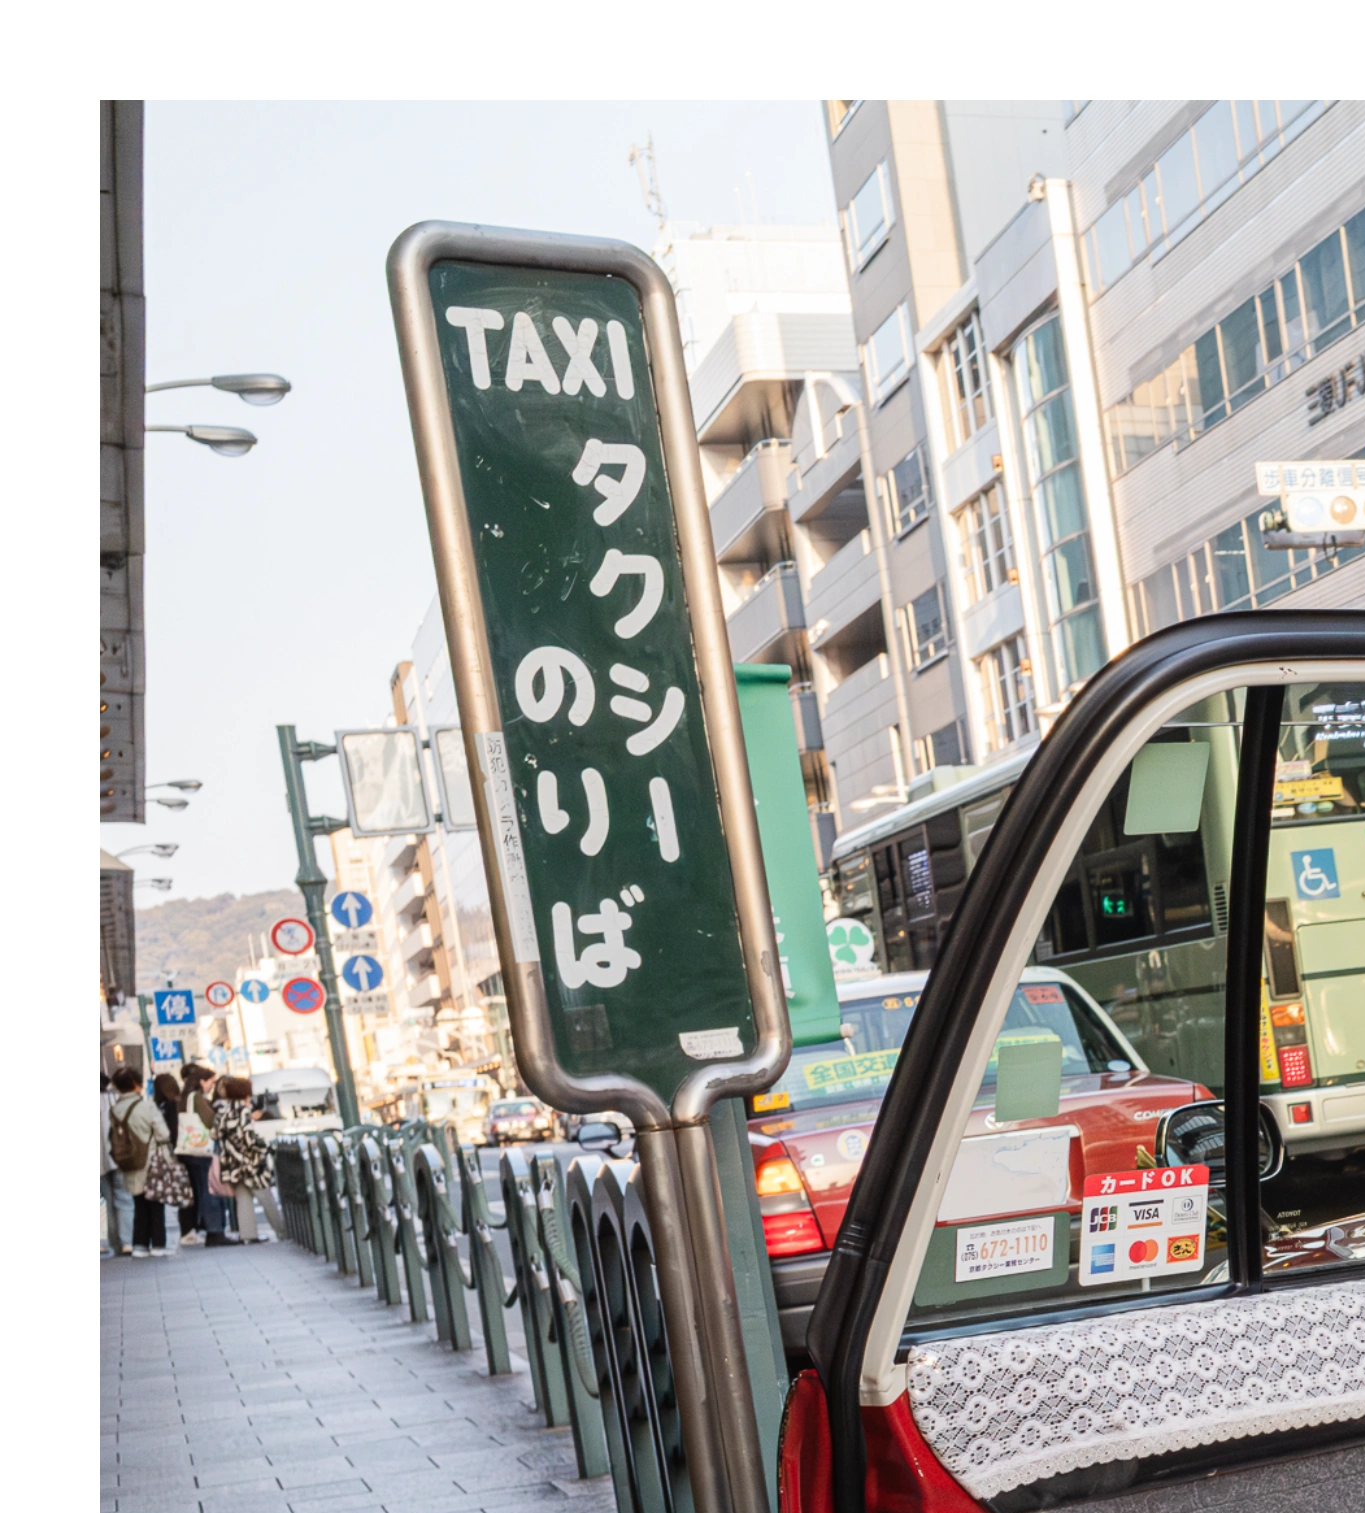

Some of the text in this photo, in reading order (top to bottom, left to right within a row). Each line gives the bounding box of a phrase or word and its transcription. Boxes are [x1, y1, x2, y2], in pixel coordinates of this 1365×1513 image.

[445, 306, 636, 400] TAXI
[572, 438, 686, 864] タクシー
[515, 645, 645, 991] のりば
[161, 994, 190, 1022] 停
[1090, 1213, 1117, 1226] JCB
[1133, 1207, 1160, 1221] VISA
[961, 1233, 1048, 1262] (075) 672-1110
[969, 1257, 1041, 1273] 京都タクシー業務センター
[1128, 1261, 1158, 1270] mastercard
